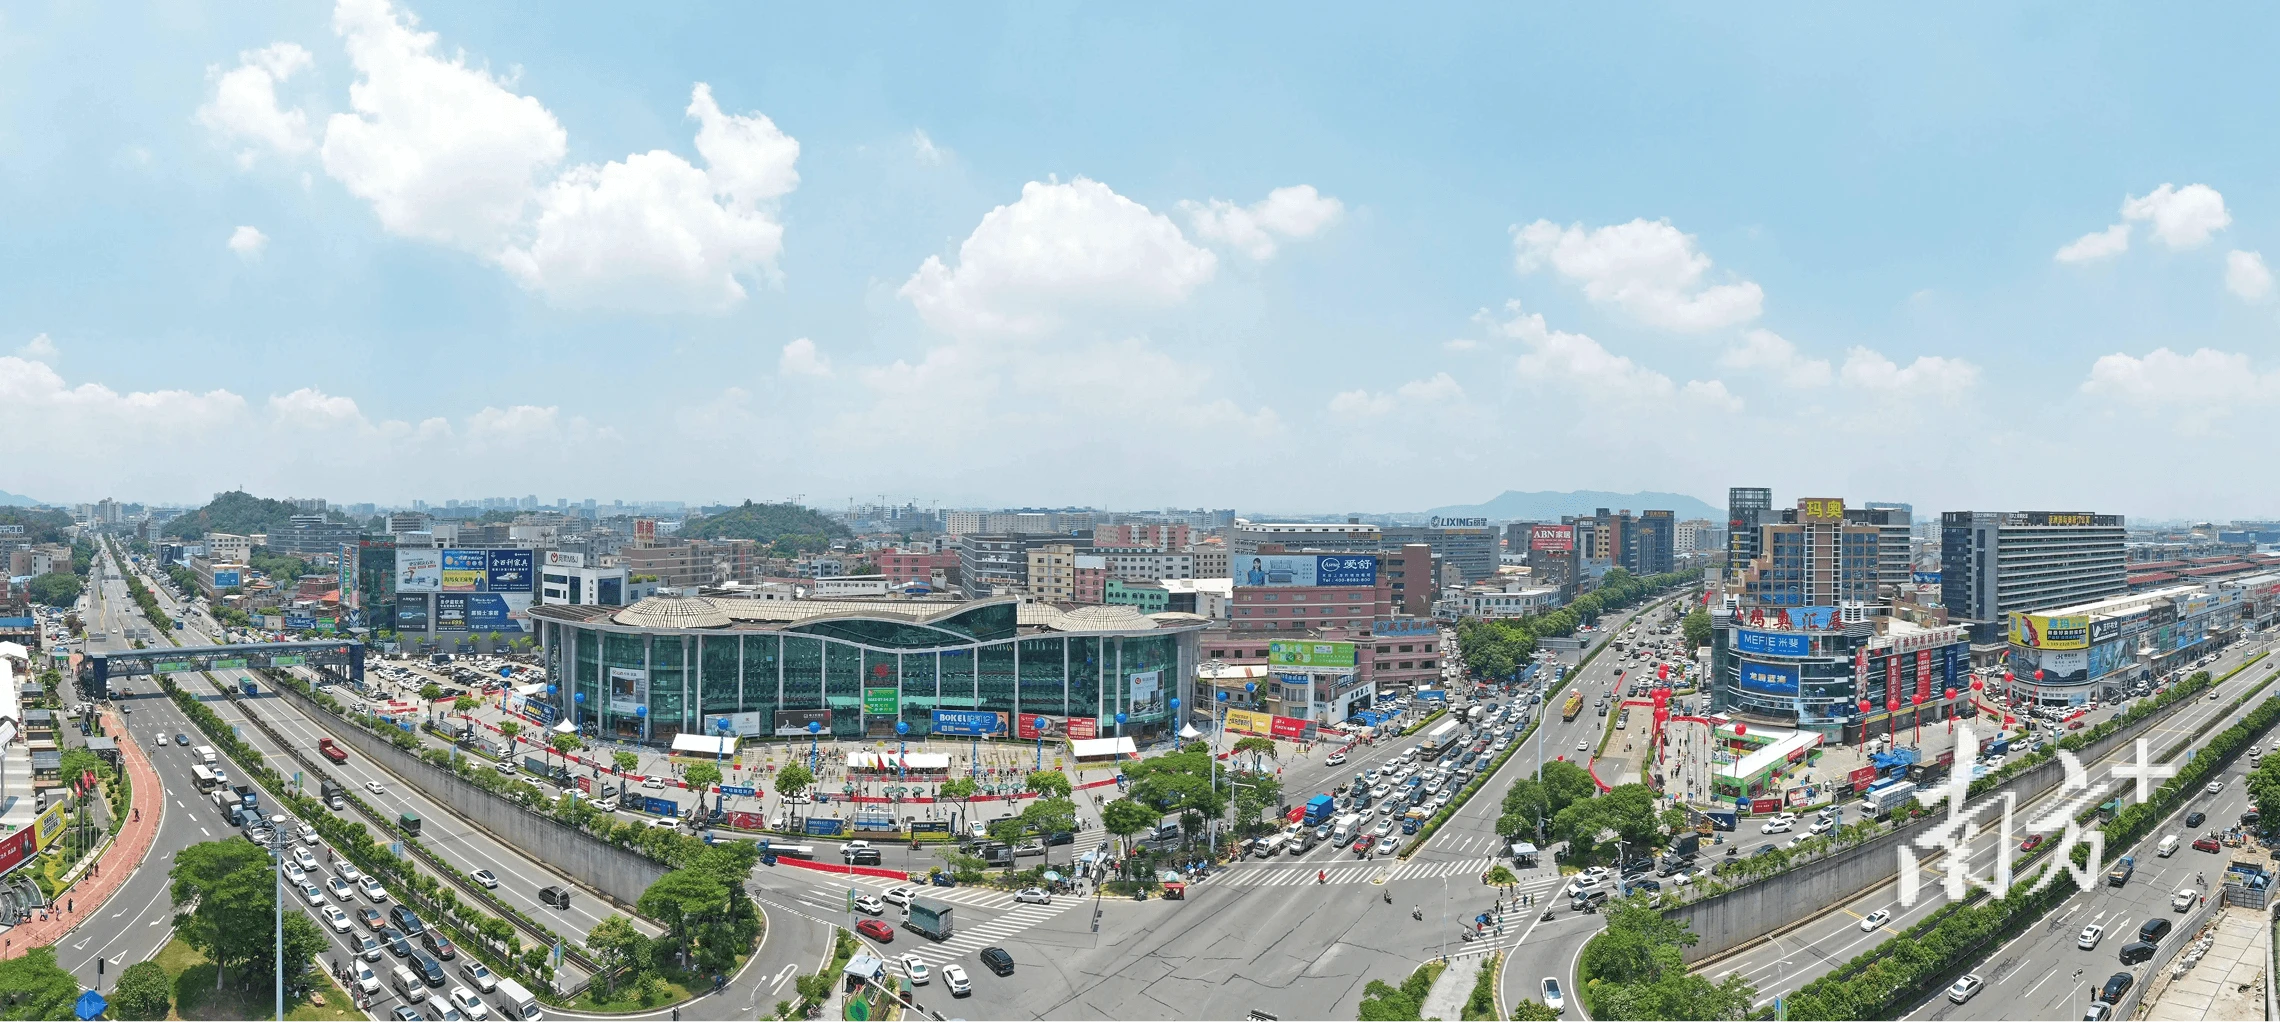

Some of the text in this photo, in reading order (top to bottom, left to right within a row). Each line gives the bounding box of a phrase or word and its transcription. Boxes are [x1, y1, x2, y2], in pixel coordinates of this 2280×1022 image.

[1806, 500, 1843, 518] 玛奥
[1441, 517, 1473, 527] LIXING
[1533, 530, 1571, 538] ABN 家居
[492, 558, 529, 568] 金百利家具
[1343, 559, 1372, 570] 爱舒
[1750, 607, 1845, 632] 玛奥汇展
[1744, 633, 1776, 647] MEFIE
[1903, 629, 1957, 648] 维纳斯国际酒店
[939, 713, 966, 723] BOKEL
